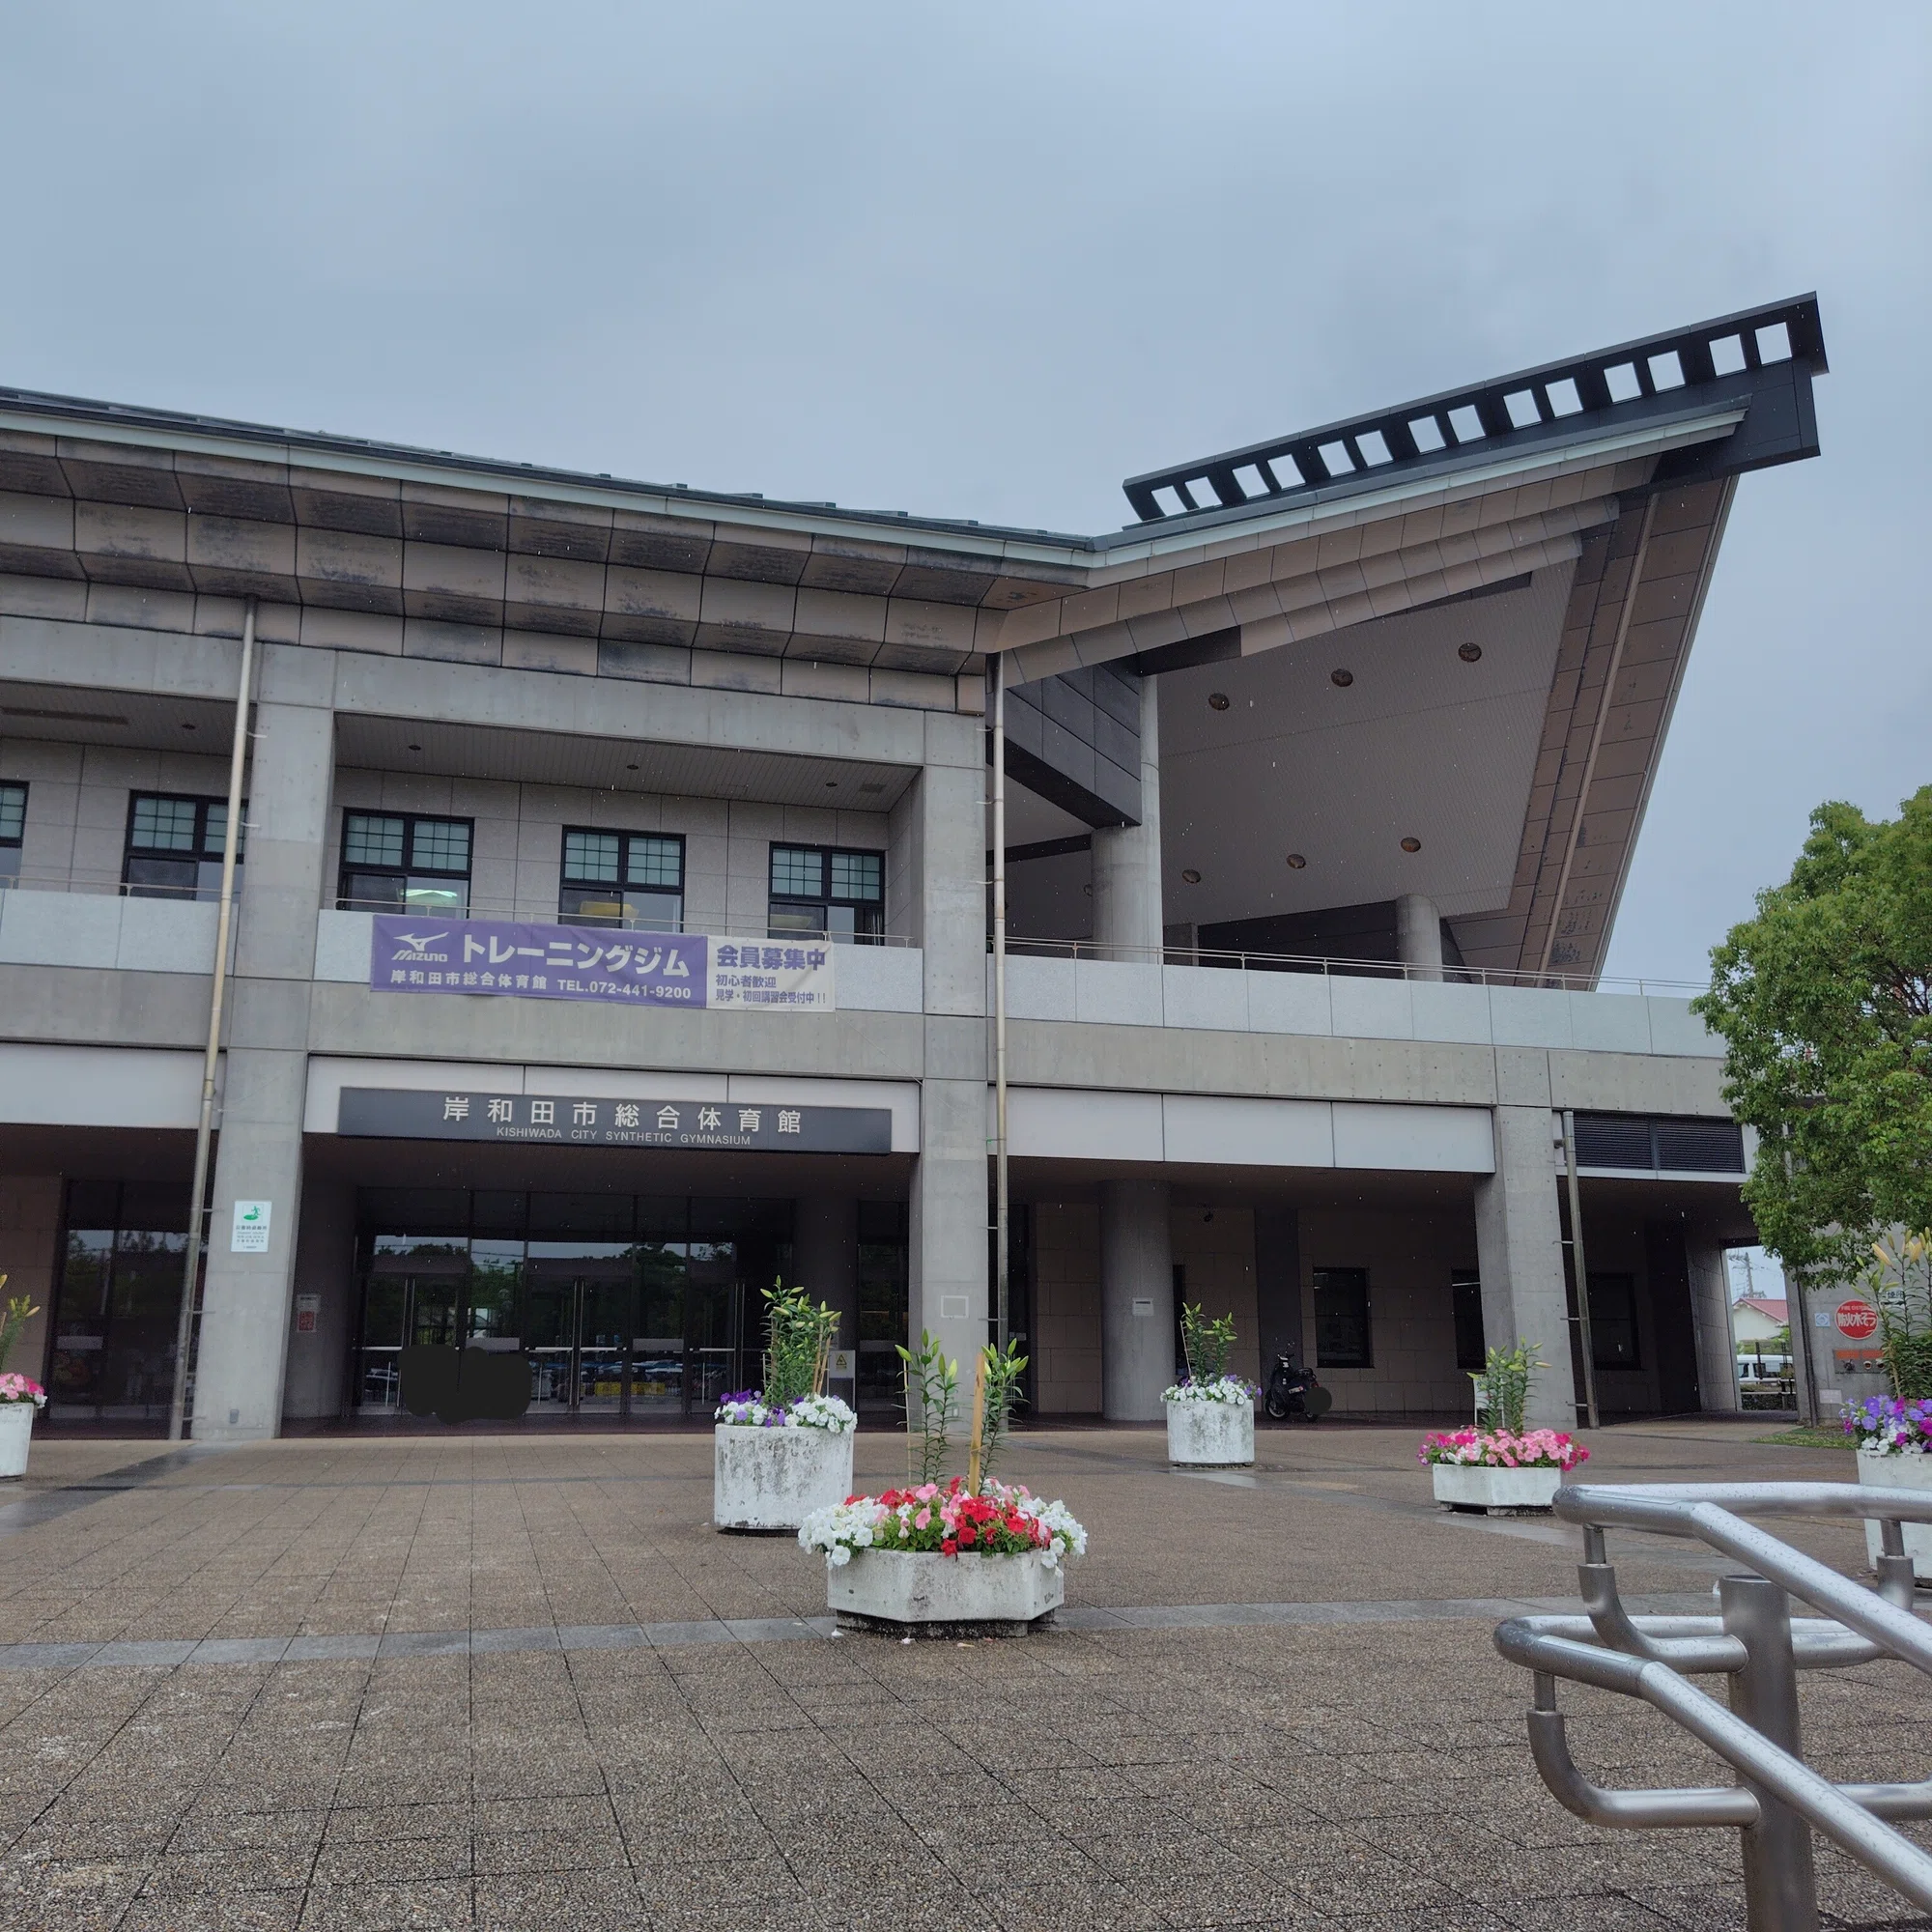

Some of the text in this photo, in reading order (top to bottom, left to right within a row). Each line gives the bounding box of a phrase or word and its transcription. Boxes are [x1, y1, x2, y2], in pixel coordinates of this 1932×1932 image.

[464, 934, 690, 978] トレーニングジム
[717, 945, 826, 971] 会員募集中
[390, 969, 691, 999] 岸和田市総合体育館 TEL.072-441-9200
[716, 974, 777, 988] 初心者歓迎
[443, 1096, 801, 1133] 岸和田市総合体育館
[497, 1126, 751, 1146] KISHIWADA CITY SYNTHETIC GYMNASIUM
